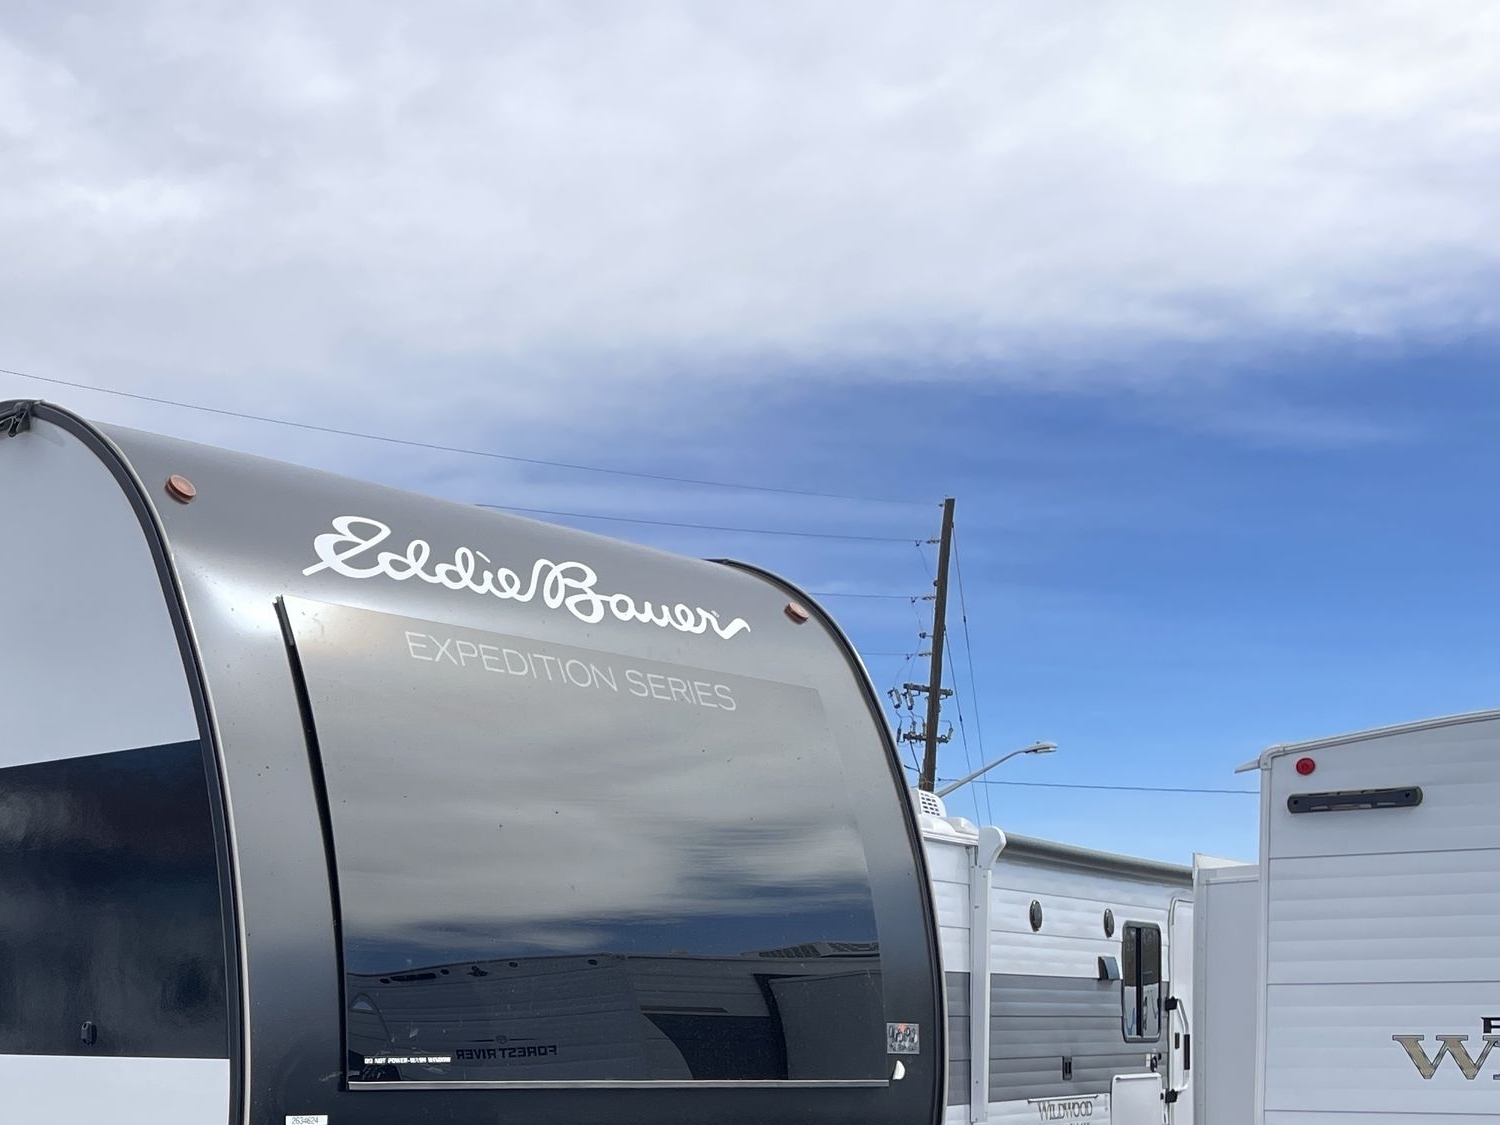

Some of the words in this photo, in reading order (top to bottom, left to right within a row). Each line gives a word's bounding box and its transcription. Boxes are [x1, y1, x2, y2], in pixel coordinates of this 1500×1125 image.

[301, 515, 533, 603] Eddie
[530, 558, 752, 640] Bauer
[404, 630, 618, 692] EXPEDITION
[625, 668, 737, 711] SERIES
[1038, 1100, 1093, 1121] WILDWOOD
